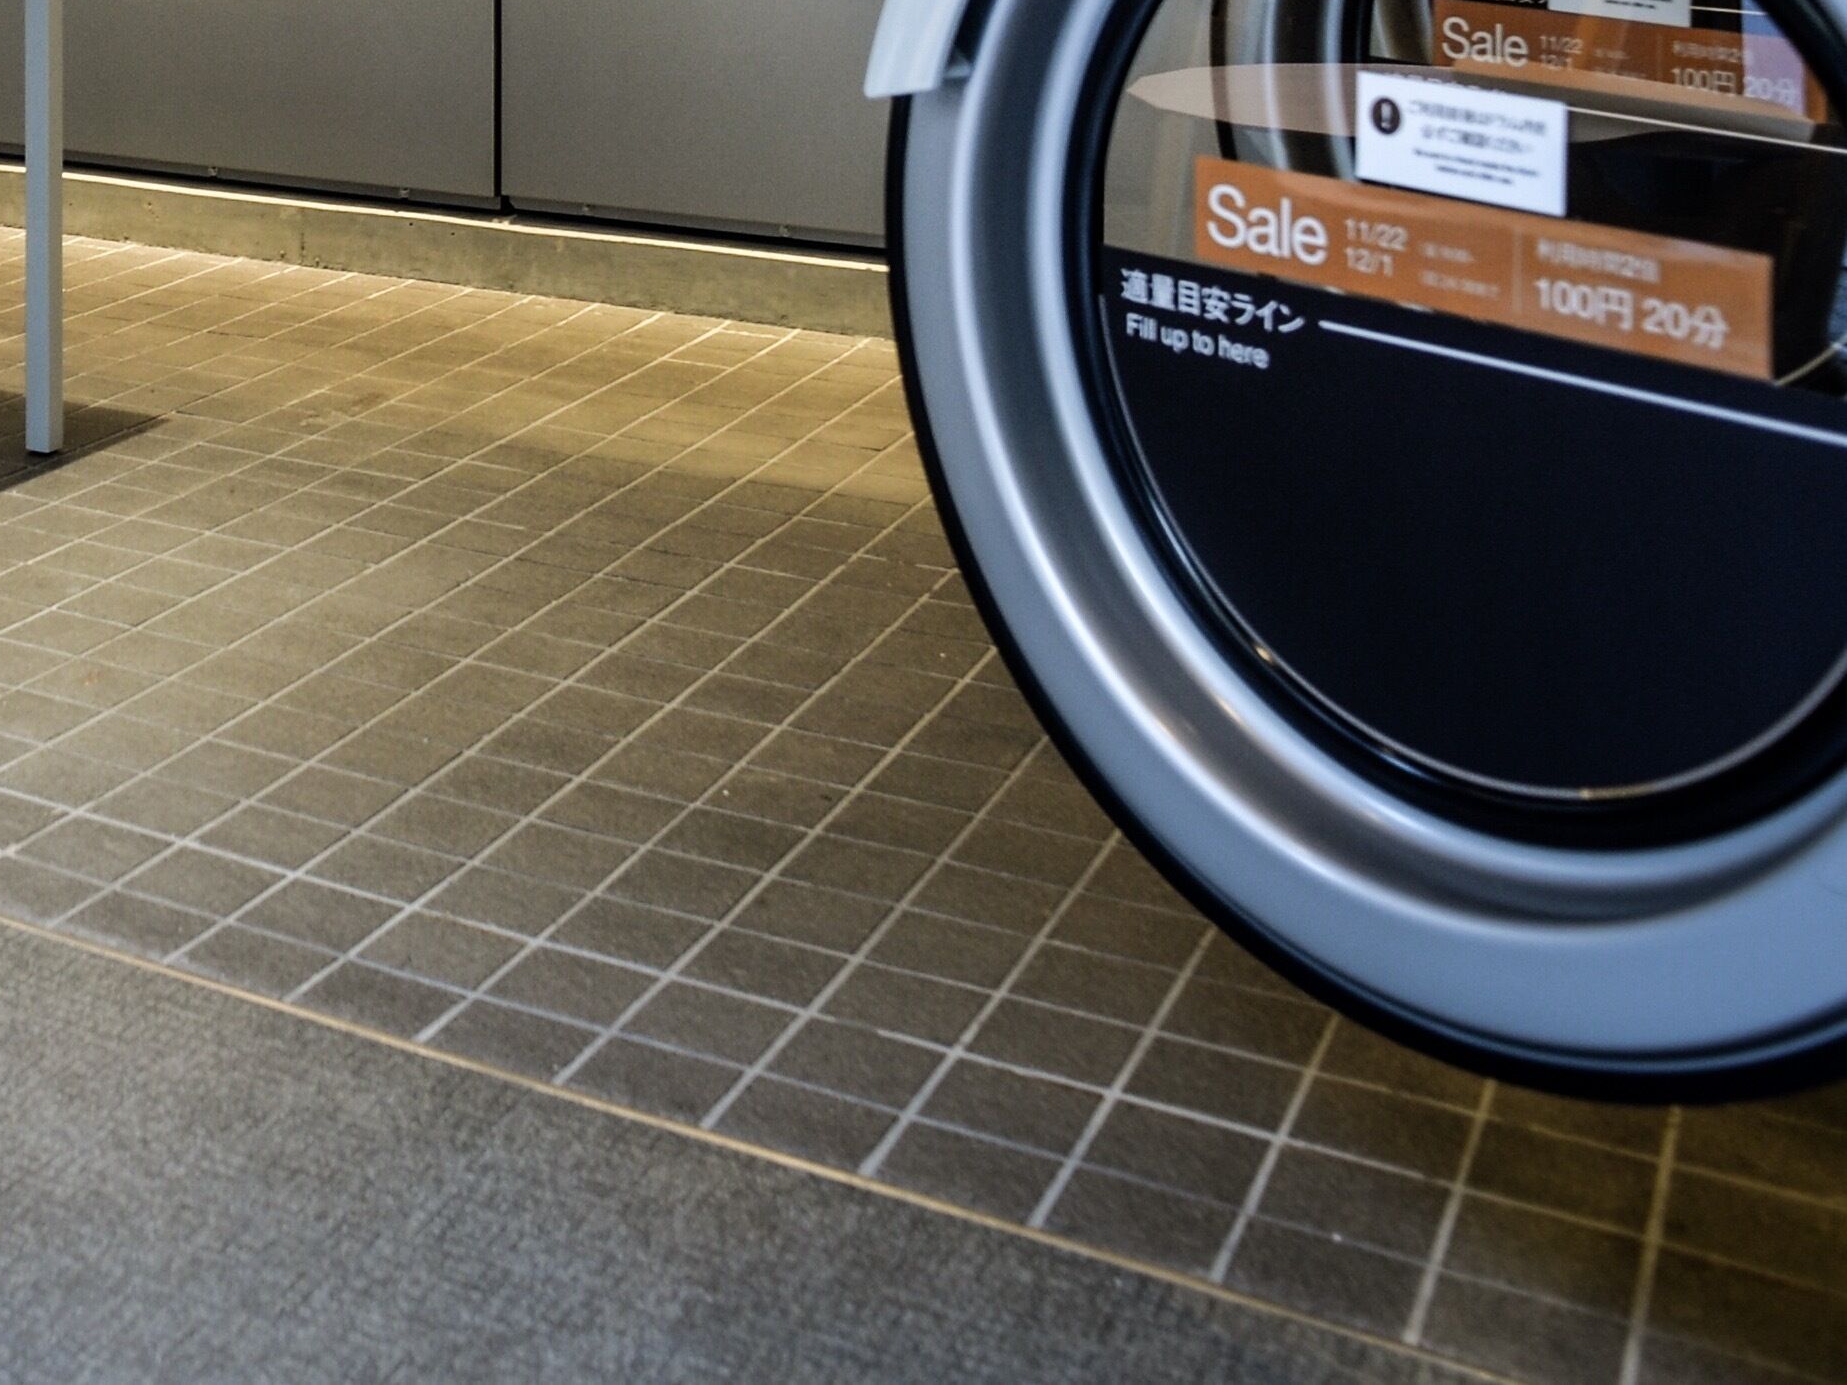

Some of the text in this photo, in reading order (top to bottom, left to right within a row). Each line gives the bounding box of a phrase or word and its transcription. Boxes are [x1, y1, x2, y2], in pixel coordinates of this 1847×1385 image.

[1442, 16, 1529, 67] Sale
[1671, 67, 1736, 96] 100円
[1207, 183, 1408, 266] Sale 11/22
[1345, 246, 1395, 276] 12/1
[1121, 268, 1305, 334] 適量目安ライン
[1535, 278, 1729, 351] 100円 20分
[1126, 313, 1270, 370] Fill up to here
